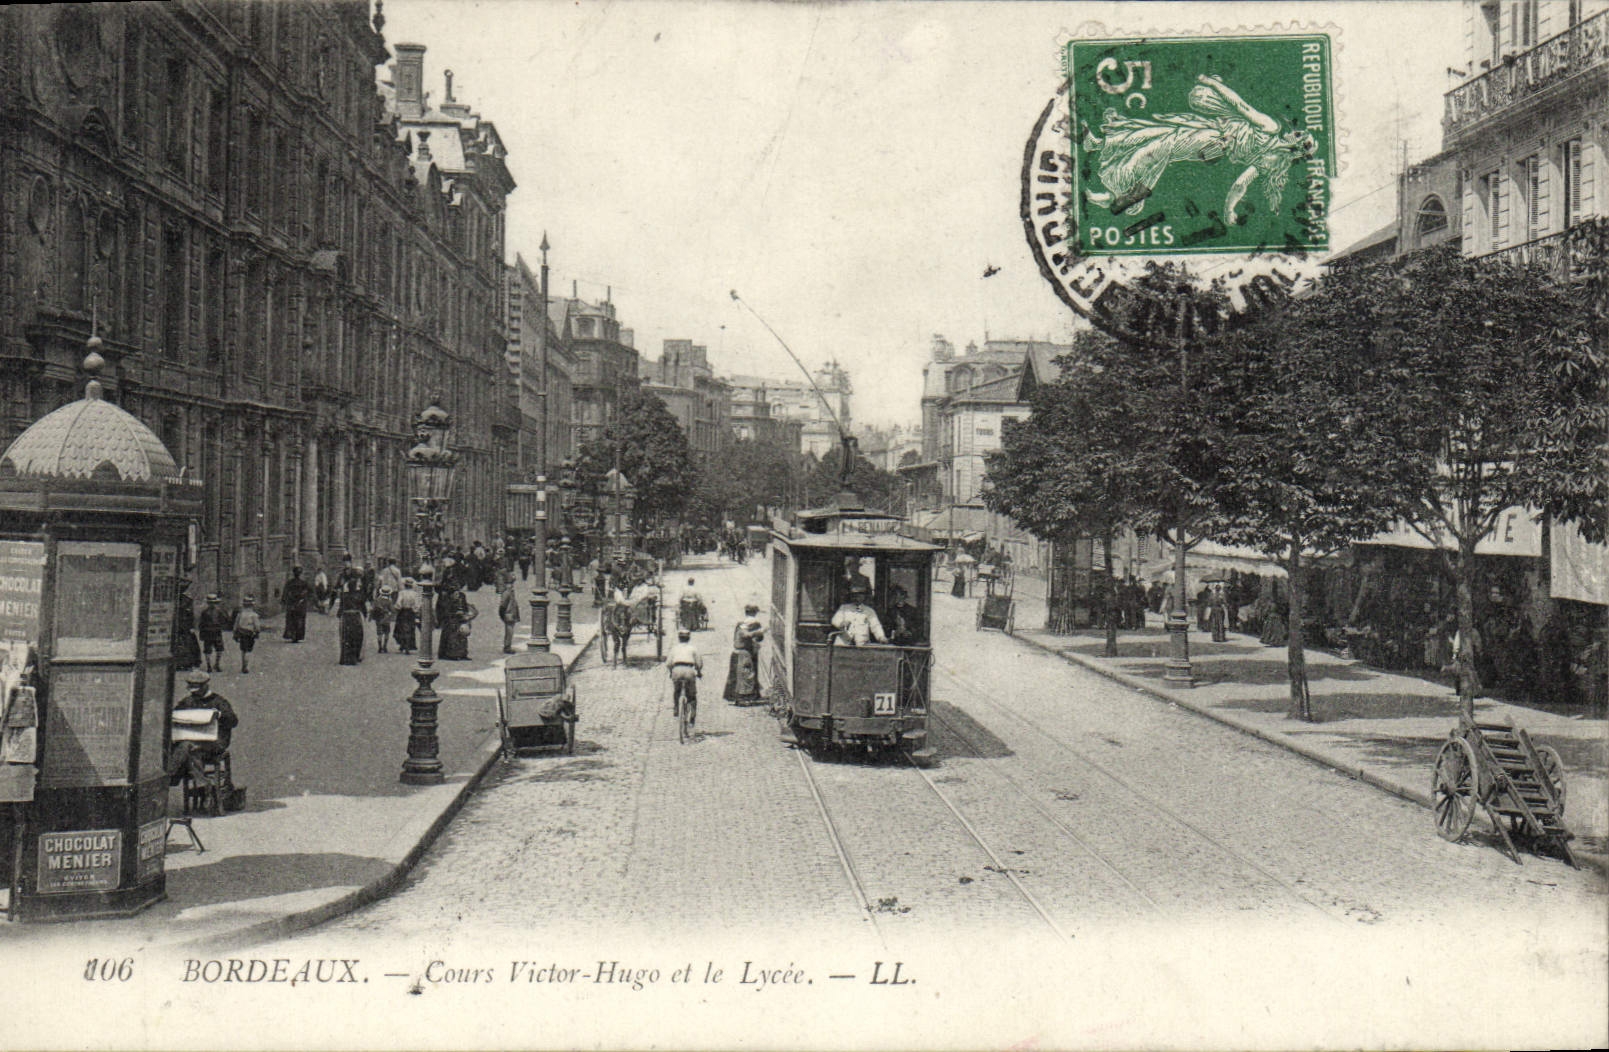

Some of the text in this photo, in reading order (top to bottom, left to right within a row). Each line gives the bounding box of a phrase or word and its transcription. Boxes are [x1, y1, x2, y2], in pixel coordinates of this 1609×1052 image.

[1302, 42, 1323, 132] REPUBLIQUE
[876, 696, 893, 711] 71
[45, 836, 116, 853] CHOCOLAT
[48, 853, 112, 870] MENIER
